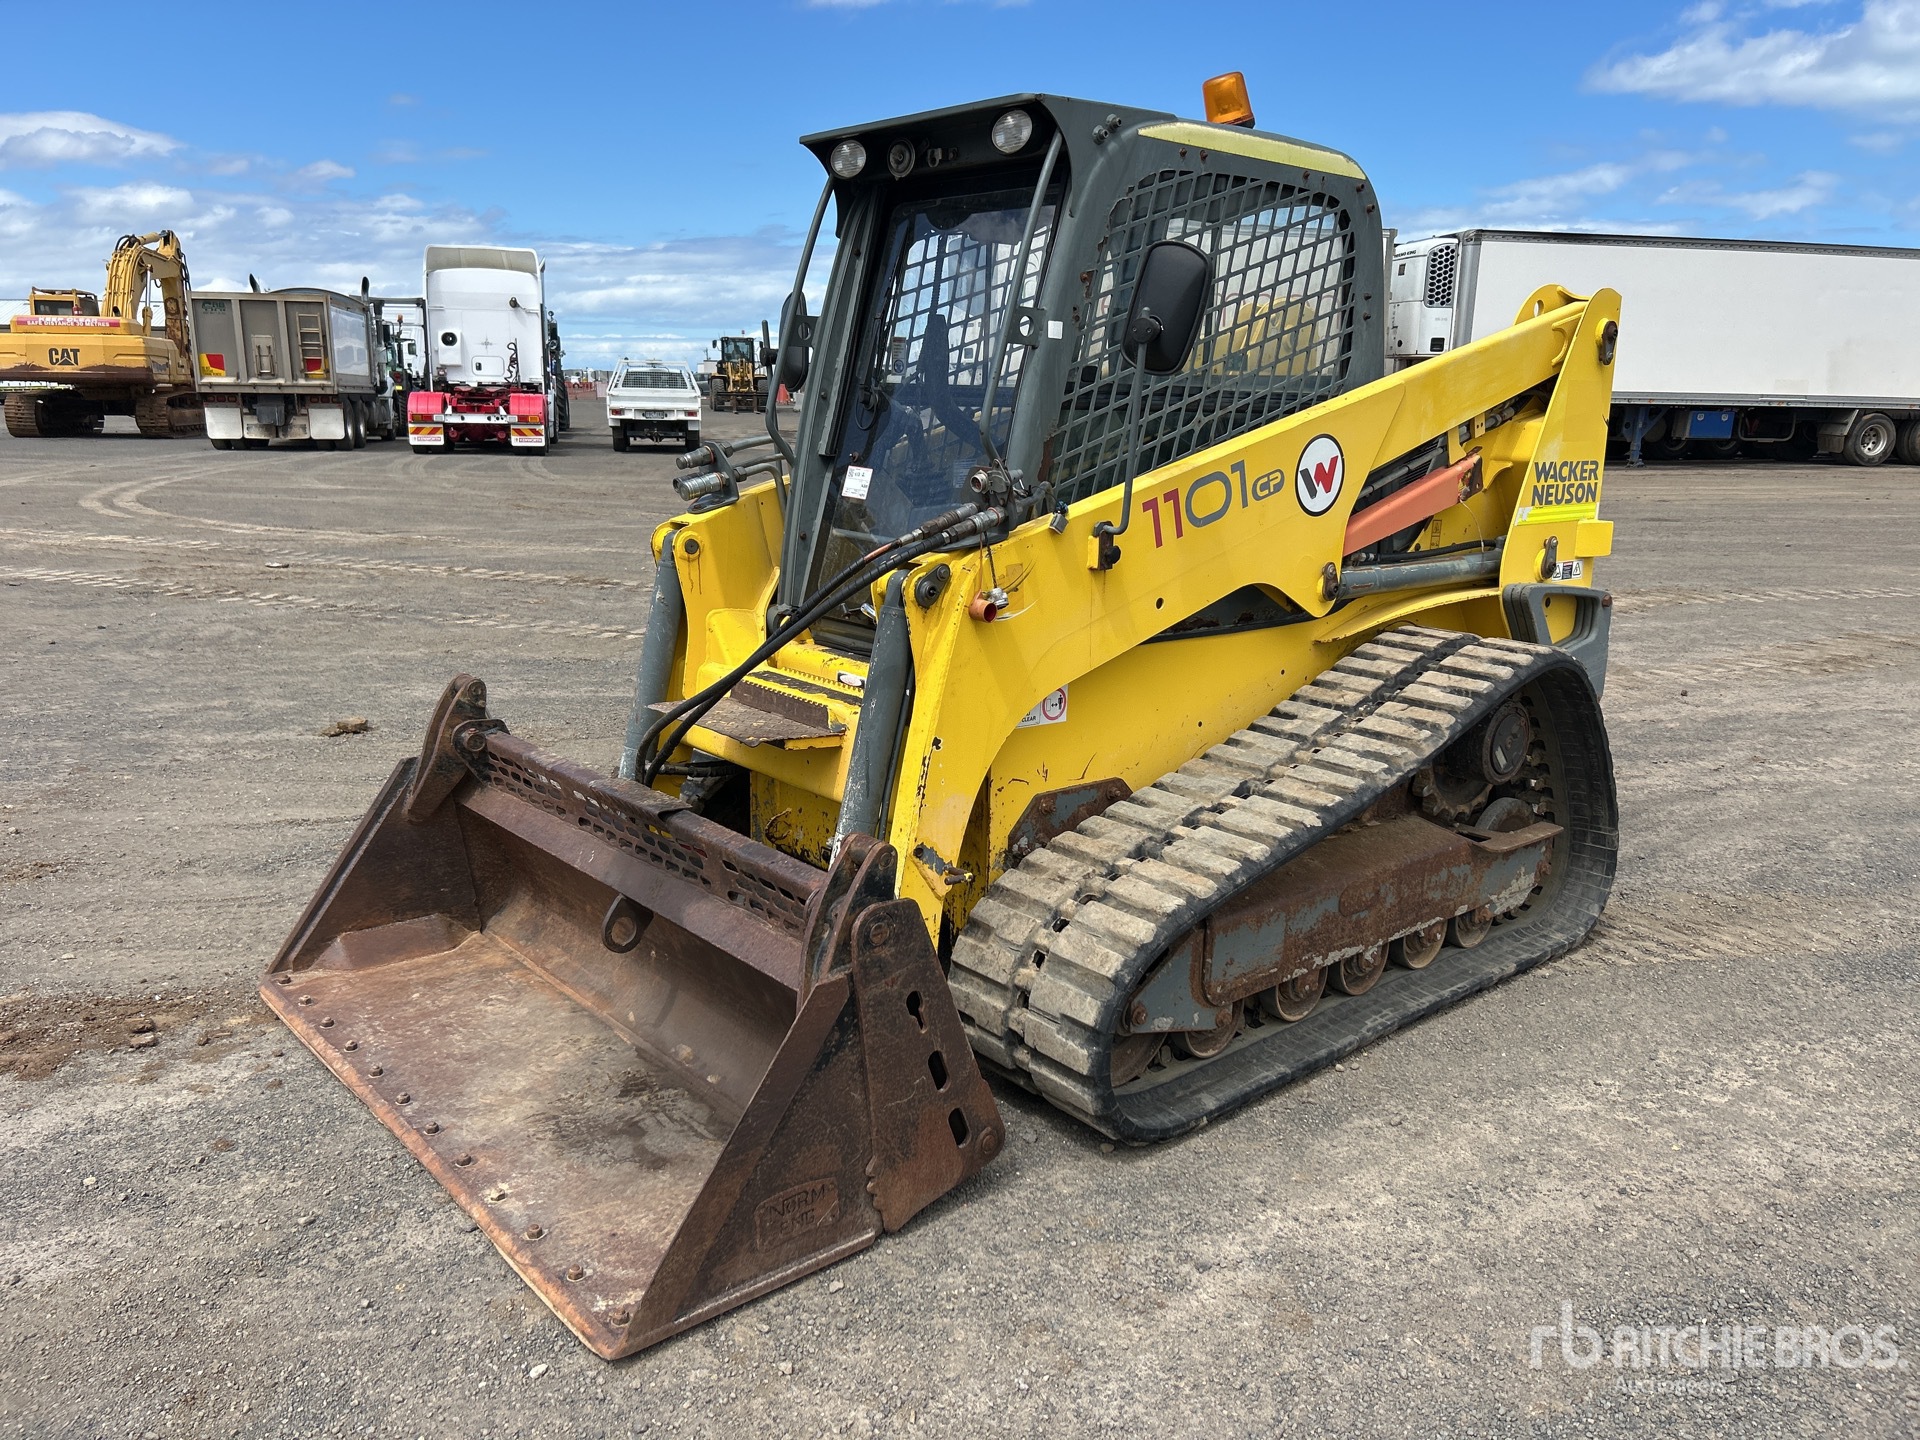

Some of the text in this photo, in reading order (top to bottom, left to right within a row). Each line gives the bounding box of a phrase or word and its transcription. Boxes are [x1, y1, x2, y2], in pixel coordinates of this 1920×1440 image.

[48, 347, 80, 366] CAT
[1534, 460, 1599, 483] WACKER
[1142, 459, 1248, 549] 1101
[1531, 482, 1598, 506] NEUSON
